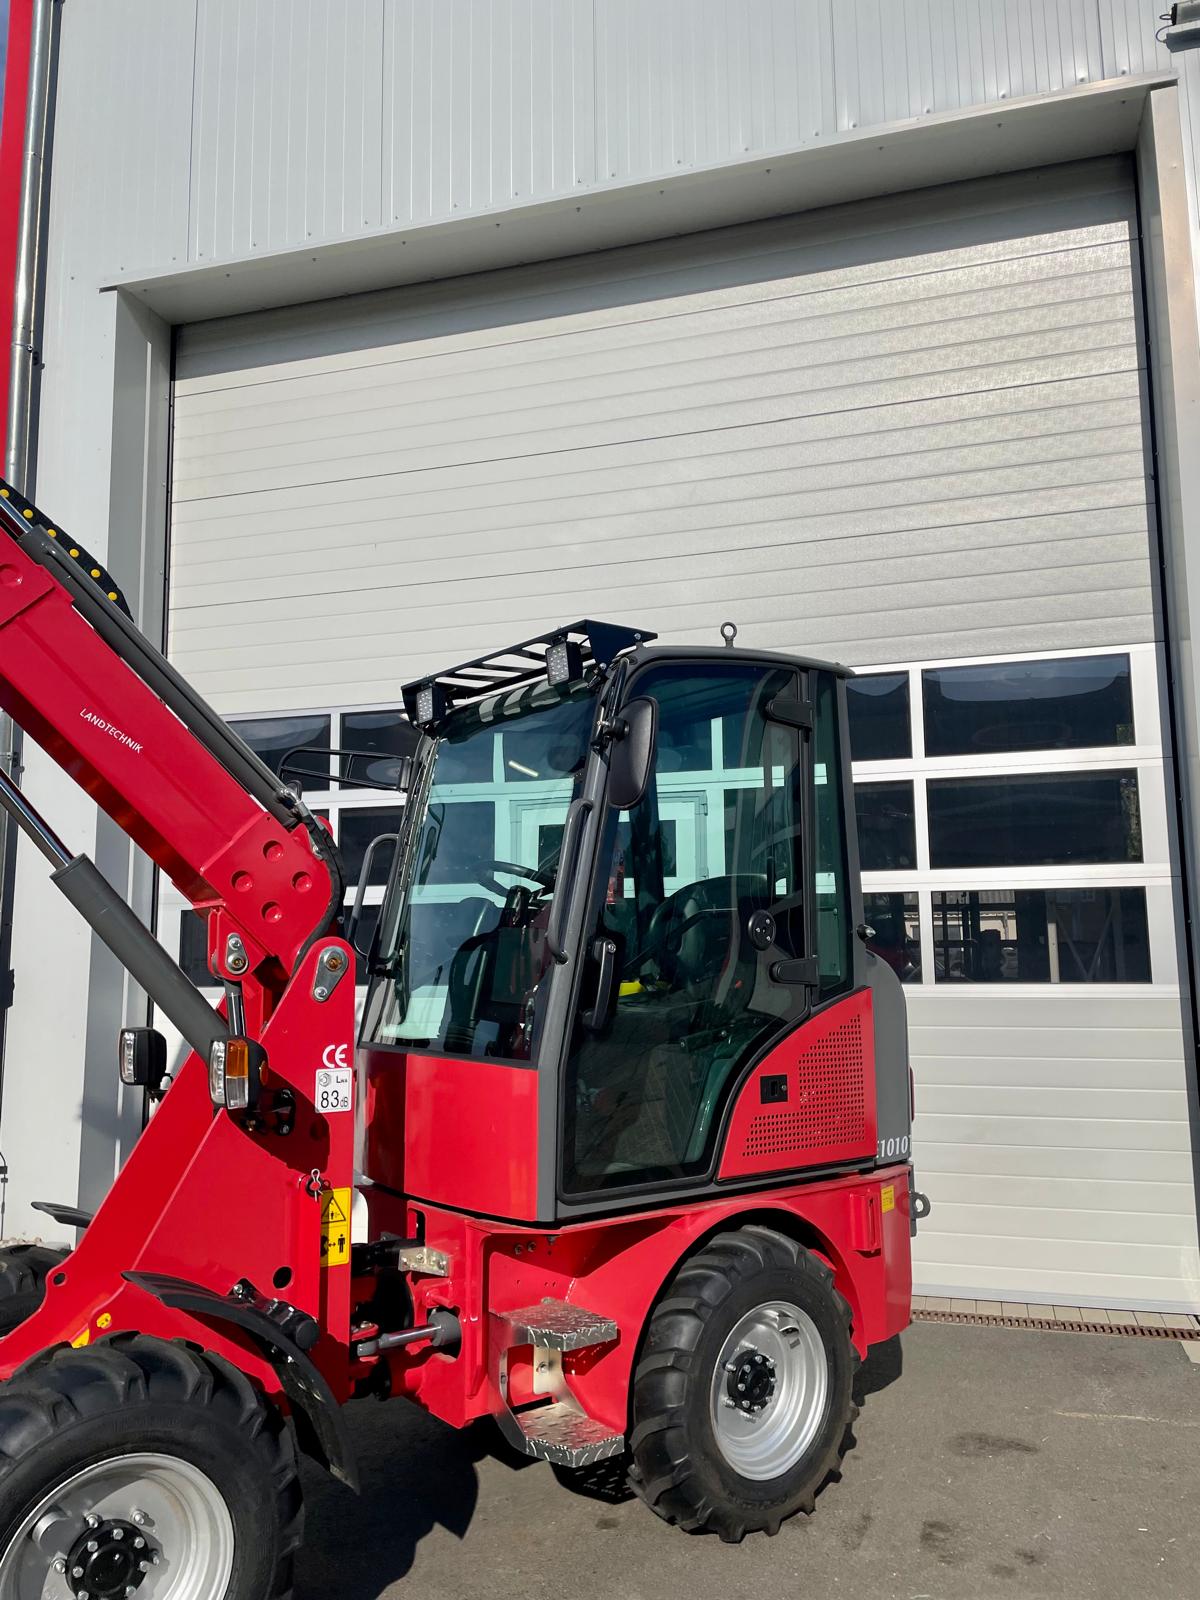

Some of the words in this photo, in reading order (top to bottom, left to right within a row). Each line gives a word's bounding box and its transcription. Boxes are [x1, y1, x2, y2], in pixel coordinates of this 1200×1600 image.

[80, 708, 143, 754] LANDTECHNIK
[322, 1044, 348, 1069] CE
[320, 1090, 339, 1108] 83
